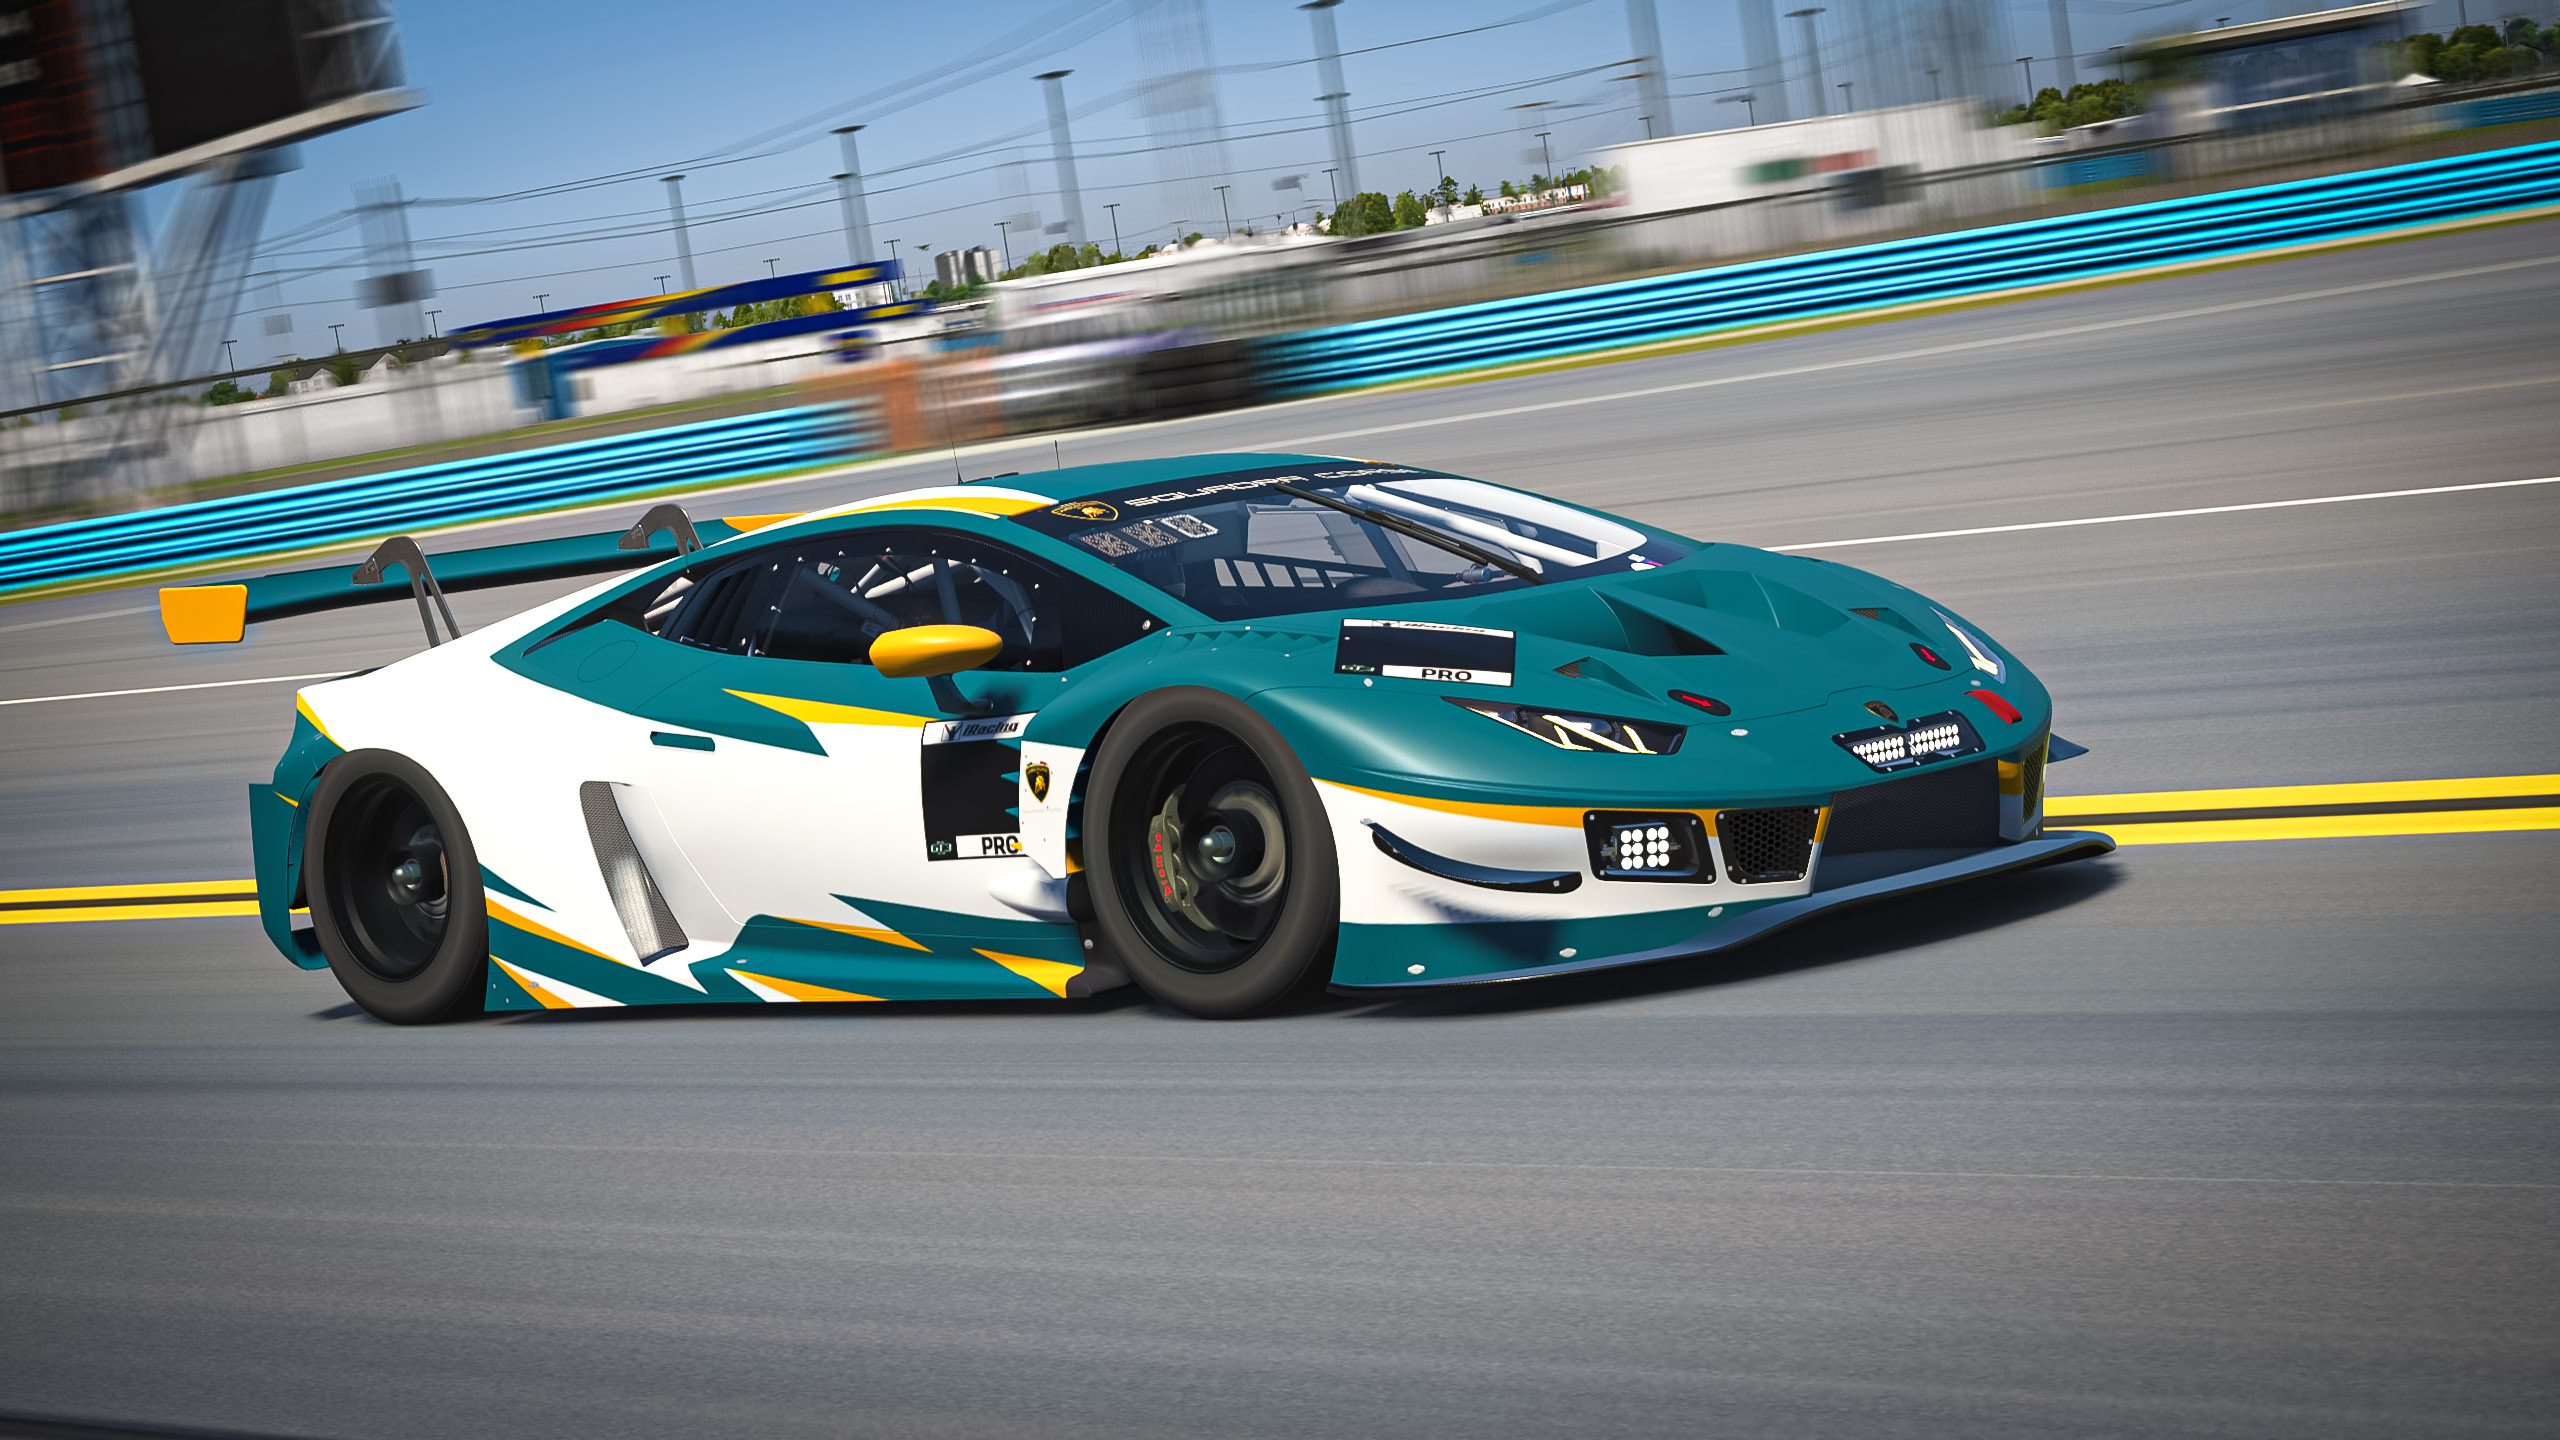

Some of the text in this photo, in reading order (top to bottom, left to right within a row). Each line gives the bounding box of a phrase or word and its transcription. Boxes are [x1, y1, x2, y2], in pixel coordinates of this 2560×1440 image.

[1124, 475, 1309, 507] SQUADRA
[1421, 668, 1472, 682] PRO
[981, 835, 1019, 856] PRO
